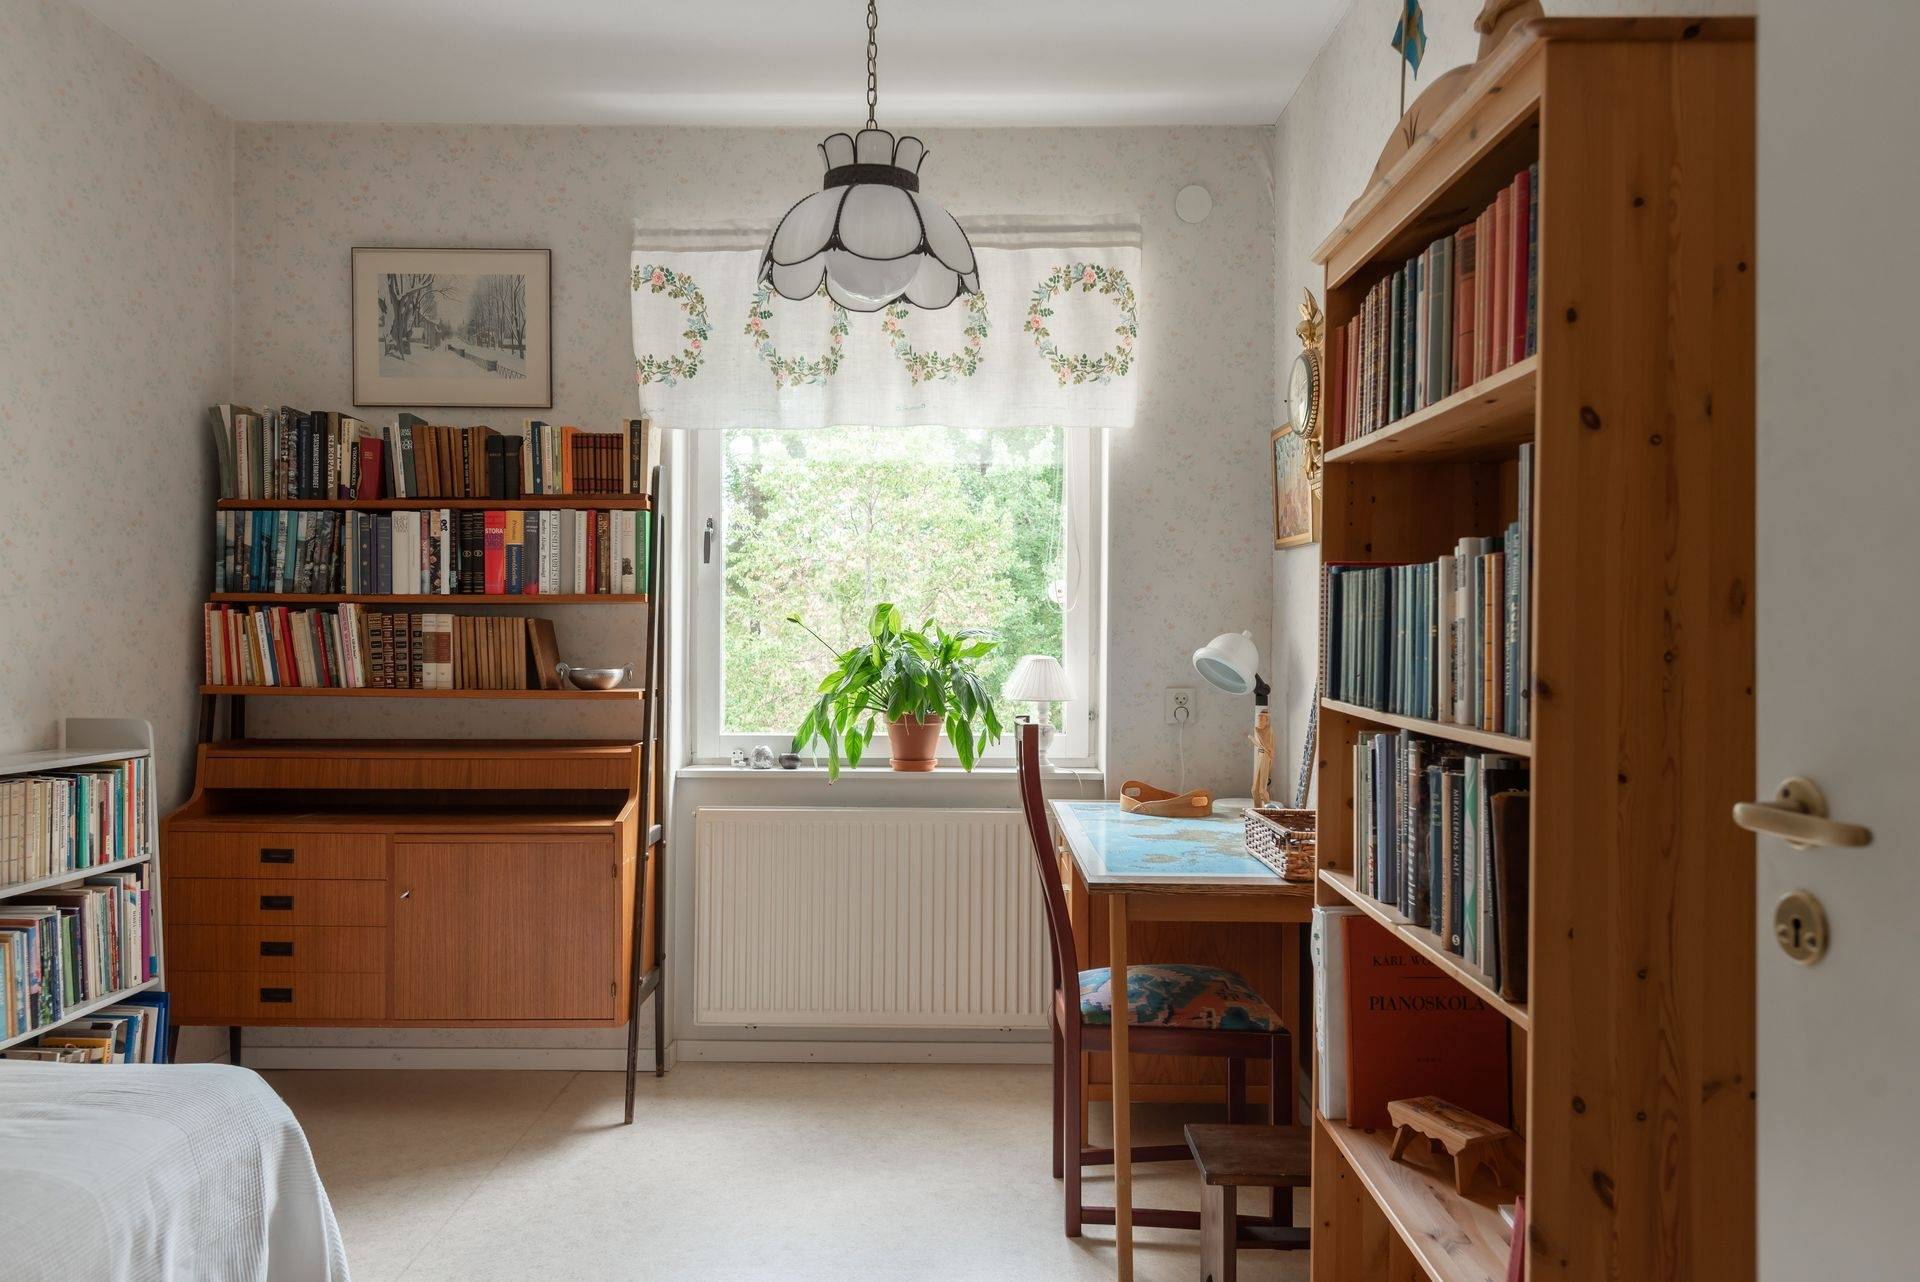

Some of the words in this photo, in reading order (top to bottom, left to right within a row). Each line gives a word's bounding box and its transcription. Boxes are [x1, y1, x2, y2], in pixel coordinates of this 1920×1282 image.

[327, 434, 335, 489] KLEOPATRA
[1452, 788, 1460, 851] MIRAKLERNAS
[1452, 853, 1460, 877] NATT
[1372, 955, 1407, 967] KARL
[1368, 995, 1486, 1011] PIANOSKOLA
